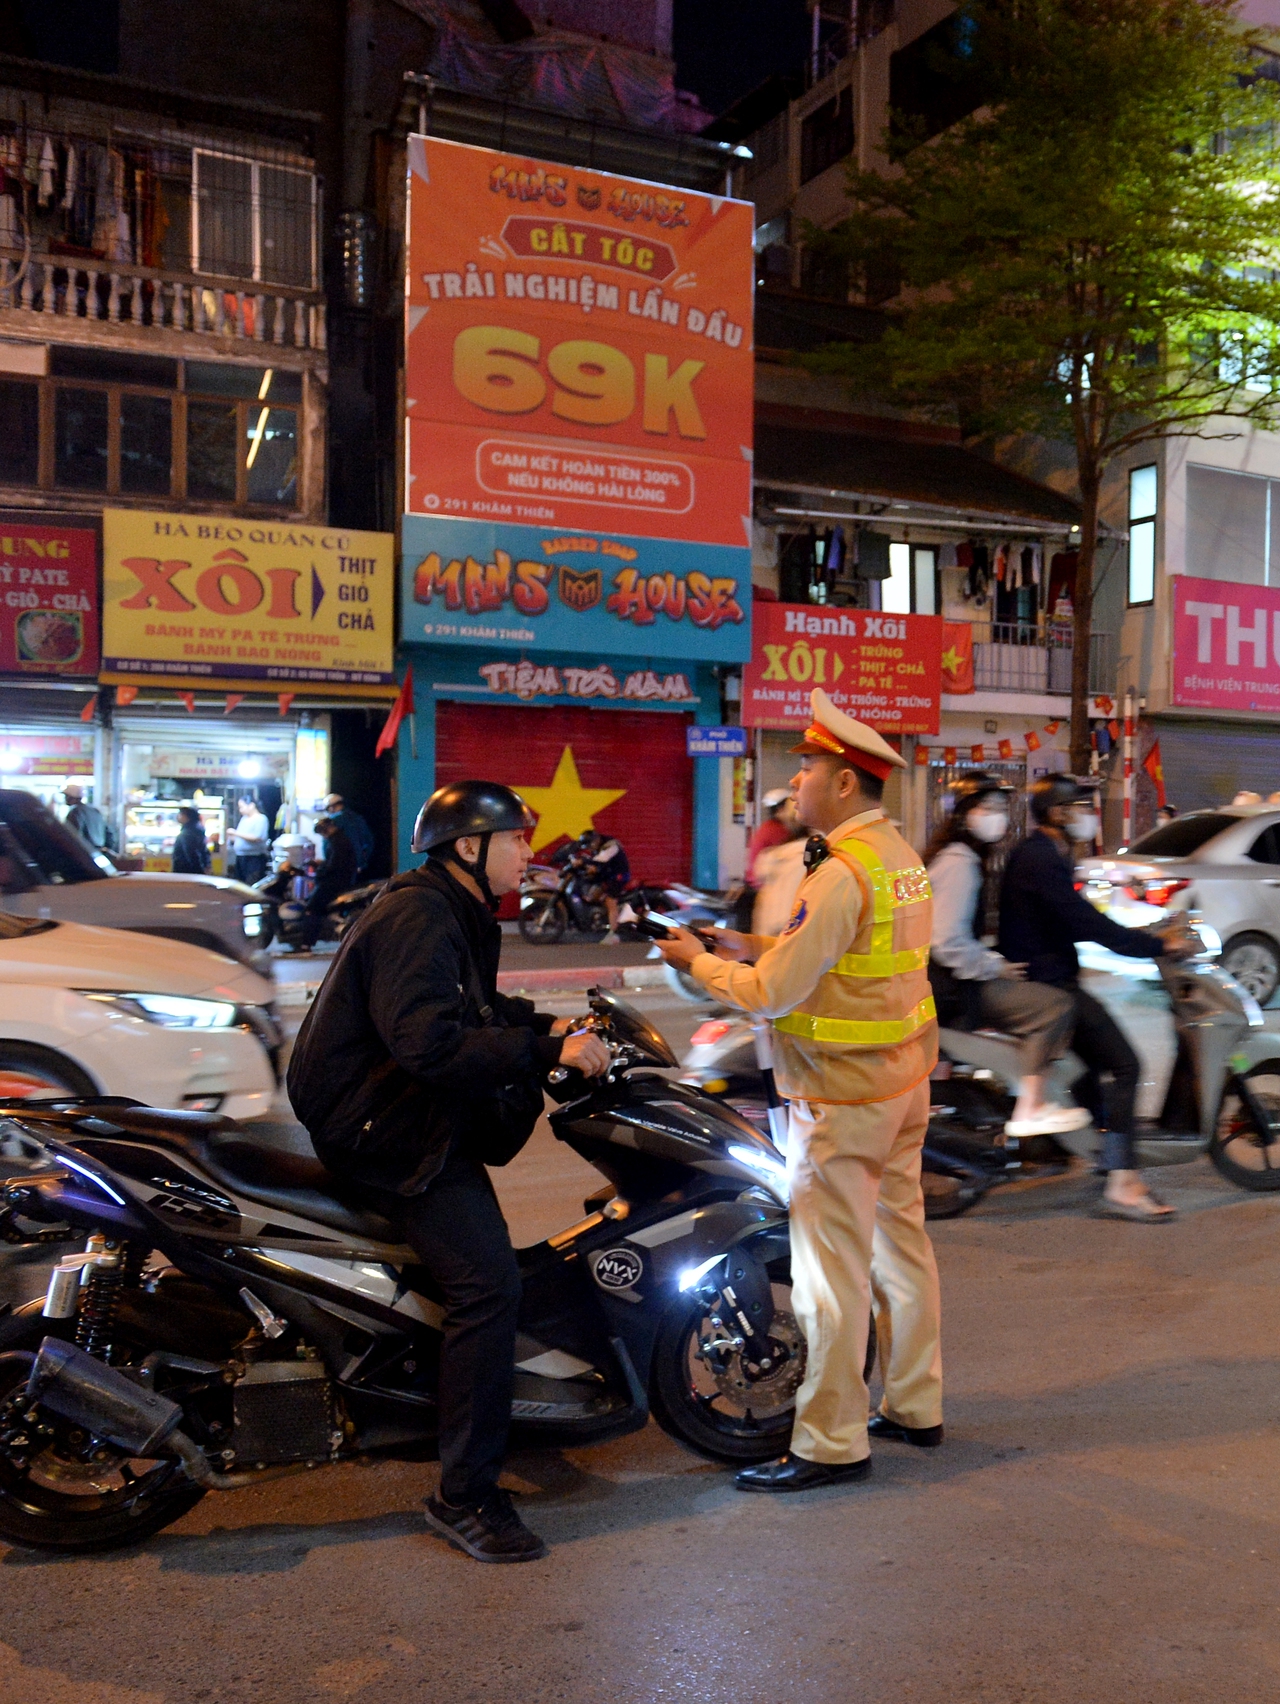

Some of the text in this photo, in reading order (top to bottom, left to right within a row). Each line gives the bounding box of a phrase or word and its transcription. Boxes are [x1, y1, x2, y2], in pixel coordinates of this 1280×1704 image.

[600, 235, 655, 271] TÓC
[423, 263, 496, 298] TRẢI
[505, 272, 619, 314] NGHIỆM
[453, 325, 706, 441] 69K
[491, 452, 528, 468] CAM
[563, 458, 605, 478] HOÀN
[542, 474, 594, 495] KHÔNG
[598, 481, 624, 498] HÀI
[627, 482, 666, 502] LÒNG
[444, 498, 467, 510] 291
[18, 567, 70, 586] PATE
[337, 555, 376, 578] THỊT
[119, 547, 302, 620] XÔI
[606, 566, 745, 631] HOUSE
[231, 628, 254, 642] PA
[435, 624, 457, 635] 291
[785, 611, 907, 640] Hạnh Xôi
[236, 644, 269, 659] BAO
[761, 640, 827, 683] XÔI
[860, 661, 886, 675] THỊT
[896, 661, 926, 675] CHẢ
[480, 660, 693, 702] TIỆM TÓC NAM
[859, 677, 876, 688] PA
[1184, 675, 1214, 691] BỆNH
[1217, 677, 1243, 693] VIỆN
[1245, 681, 1280, 694] TRUNG
[753, 686, 786, 701] BÁNH
[784, 704, 814, 716] BÁN
[598, 1258, 637, 1280] NVX
